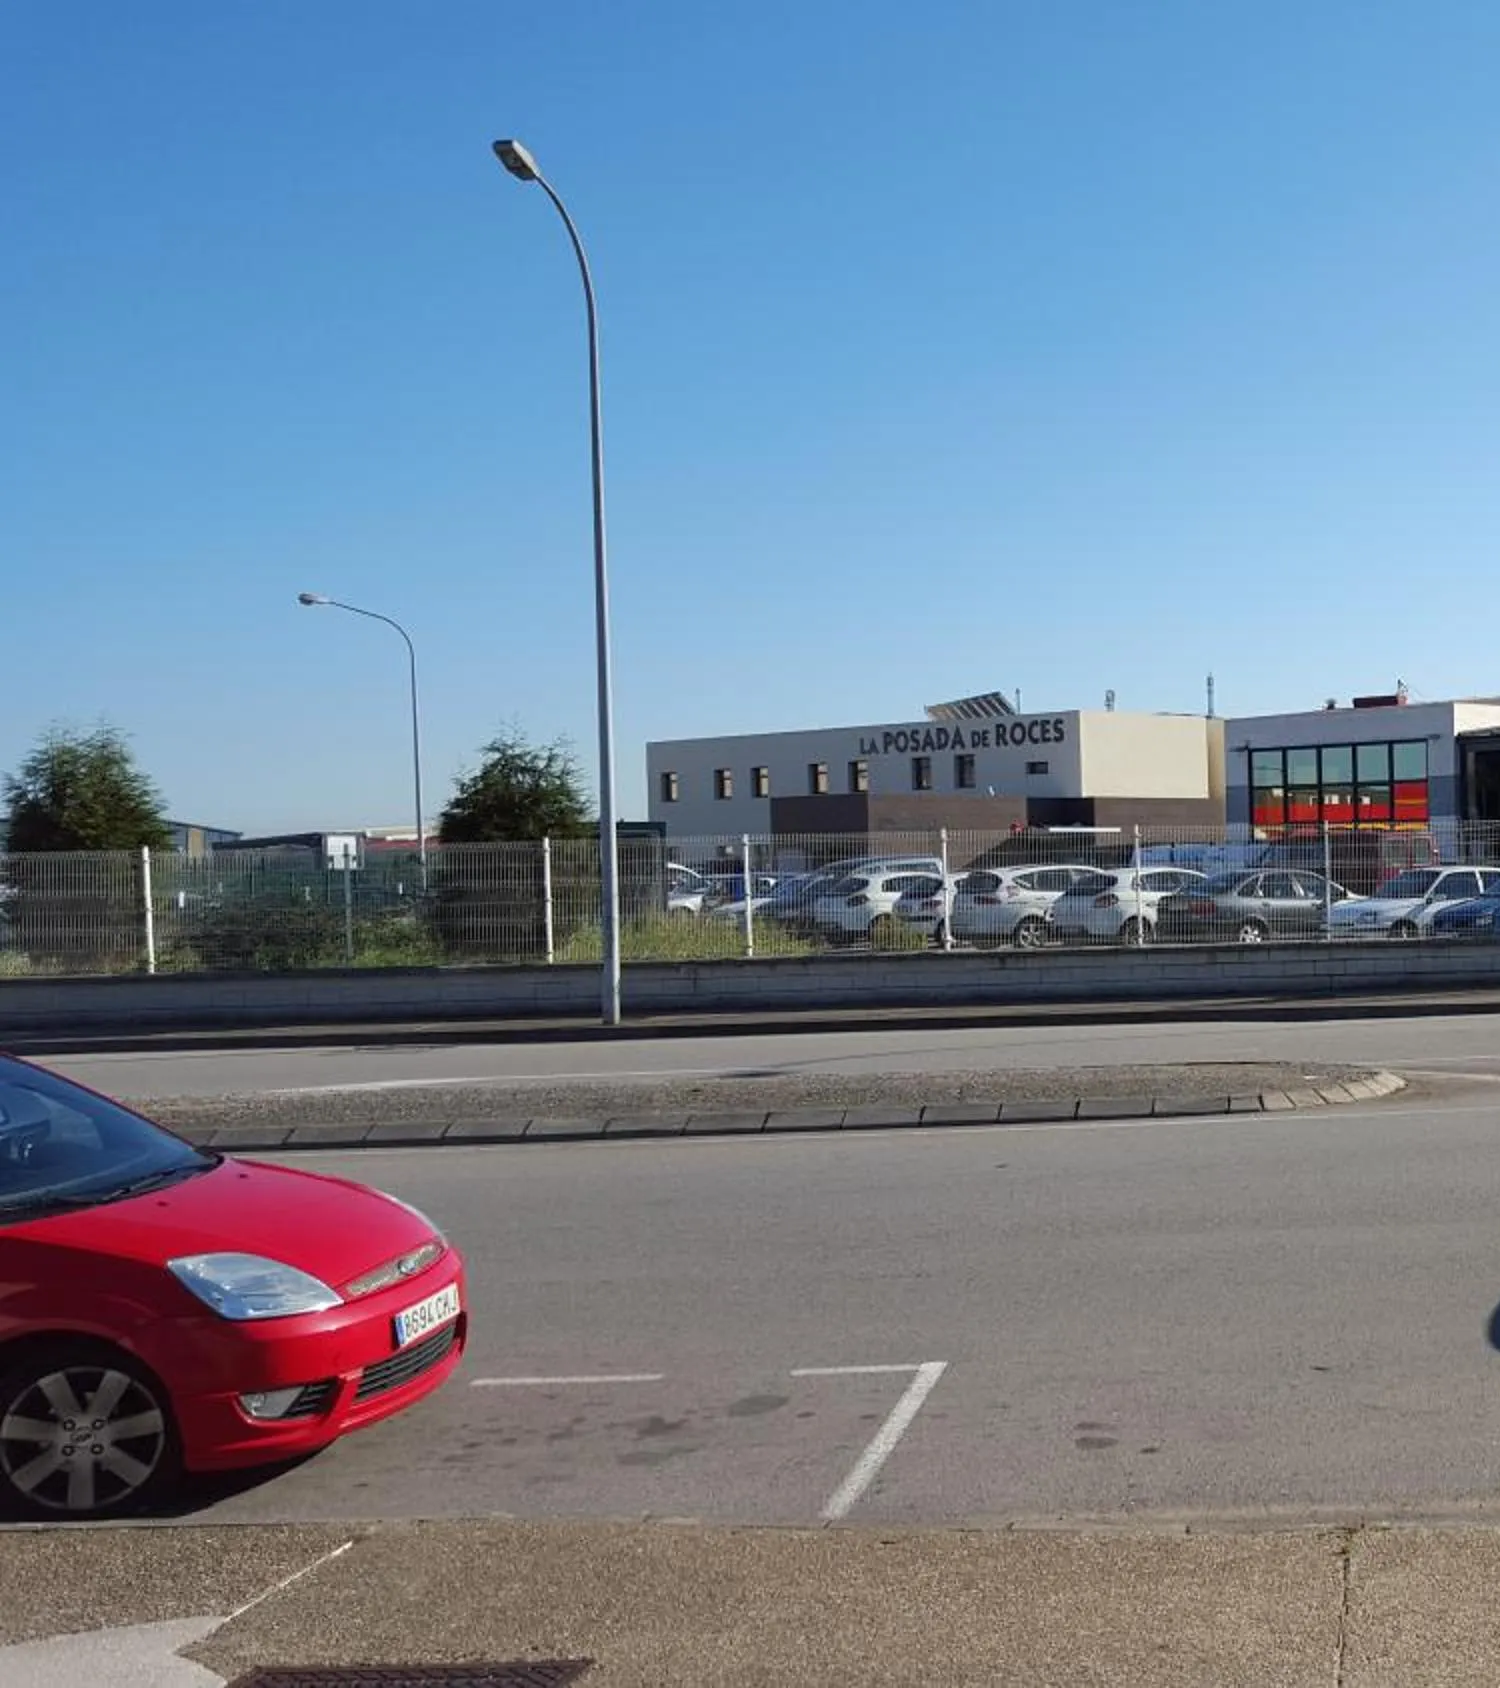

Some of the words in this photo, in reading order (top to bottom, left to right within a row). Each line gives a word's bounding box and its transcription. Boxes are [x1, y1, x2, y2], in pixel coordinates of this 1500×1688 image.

[860, 737, 880, 755] LA
[882, 726, 965, 754] POSADA
[971, 729, 990, 749] DE
[995, 718, 1065, 747] ROCES
